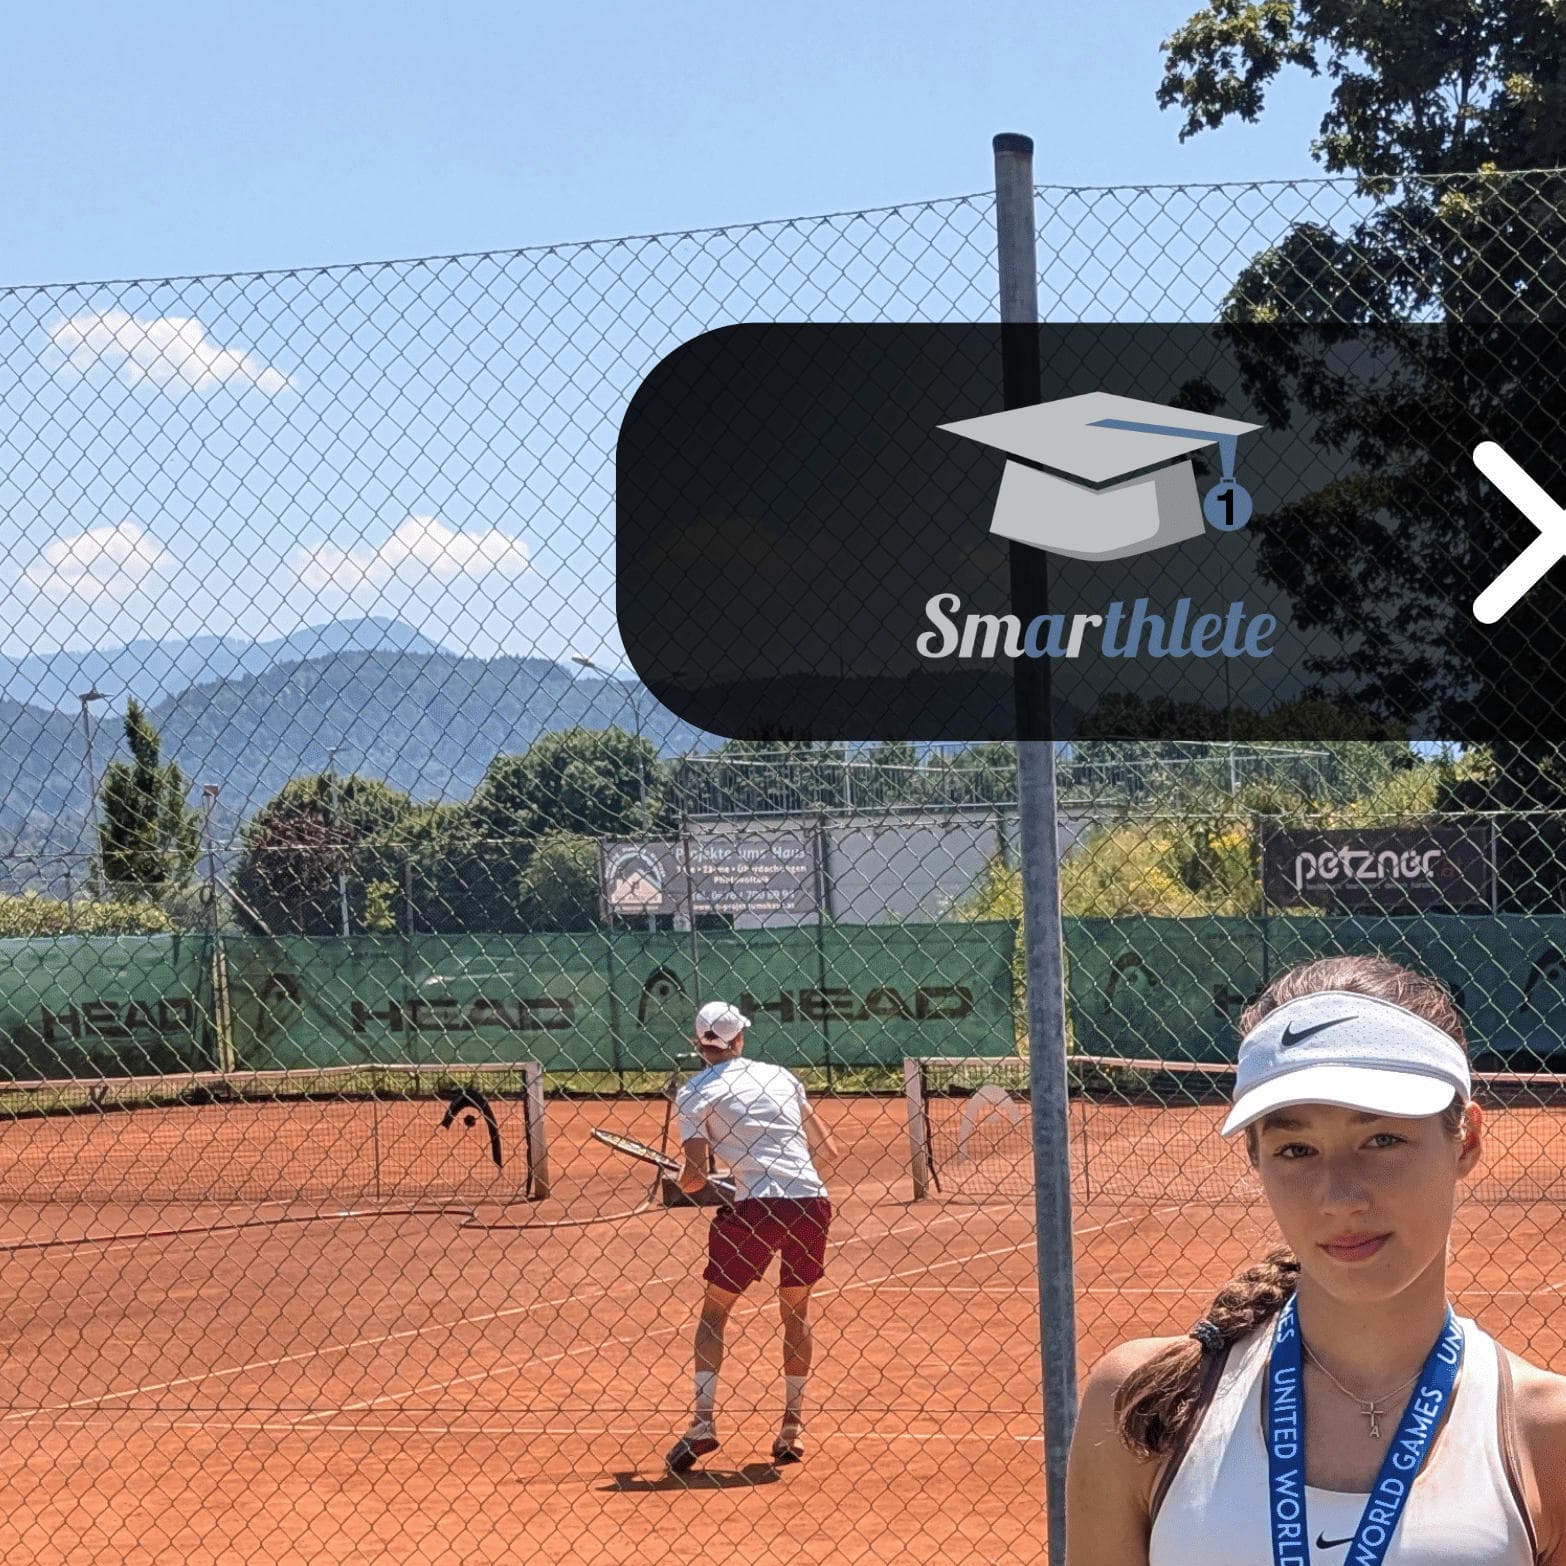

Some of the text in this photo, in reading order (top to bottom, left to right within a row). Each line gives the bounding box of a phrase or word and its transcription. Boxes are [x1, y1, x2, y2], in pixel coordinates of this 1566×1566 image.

[675, 847, 731, 863] Pojekte
[1295, 846, 1441, 889] petzner
[42, 998, 194, 1039] HEAD
[352, 998, 575, 1033] HEAD
[741, 986, 974, 1024] HEAD
[1274, 1367, 1298, 1459] UNITED
[1392, 1386, 1443, 1470] GAMES
